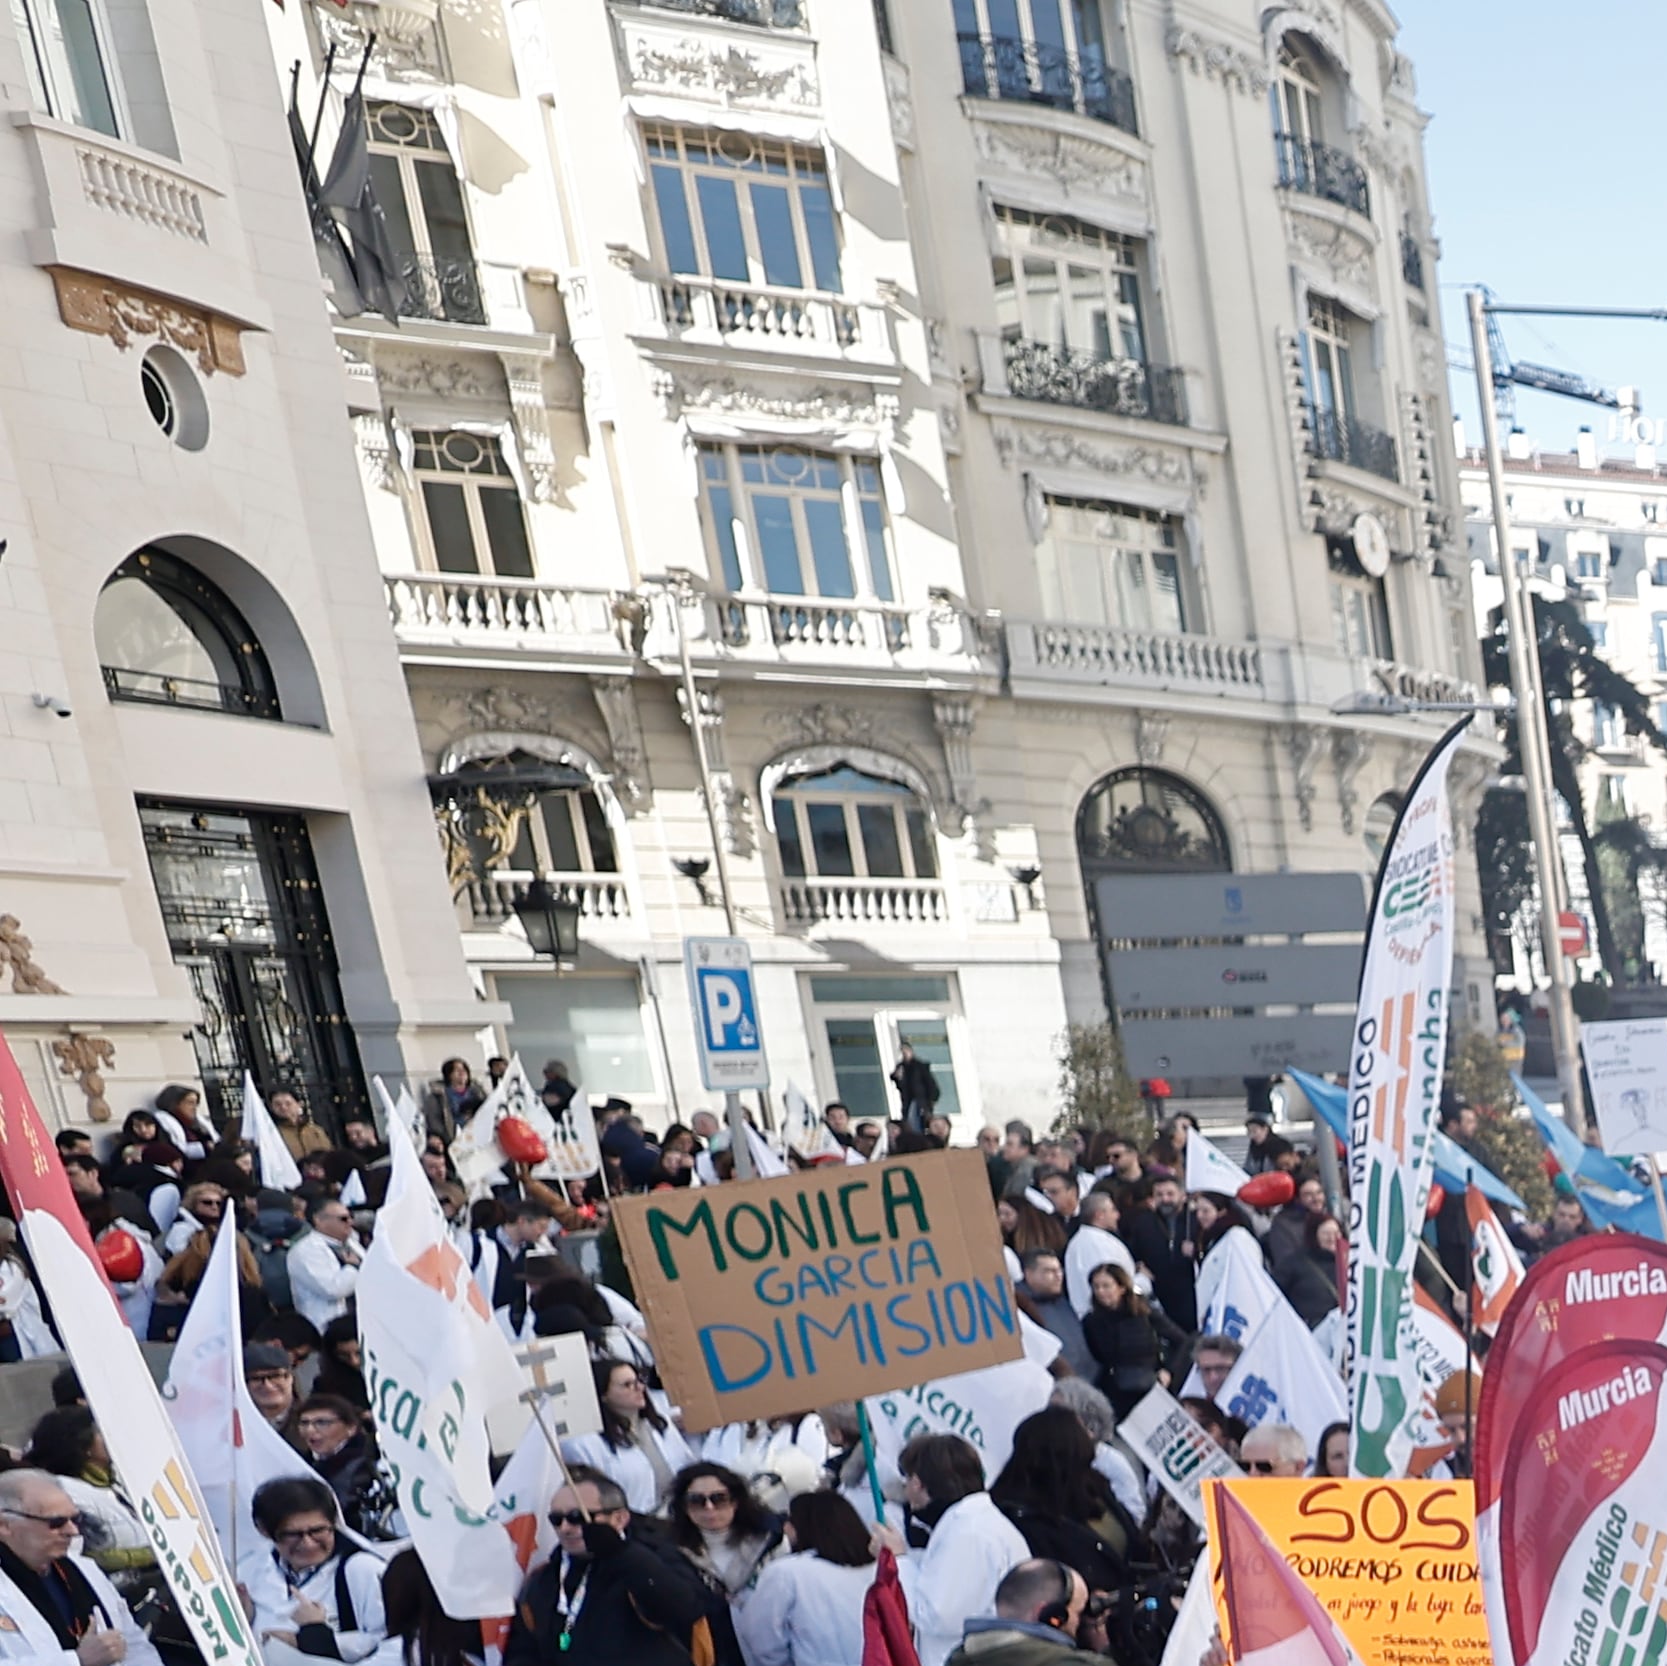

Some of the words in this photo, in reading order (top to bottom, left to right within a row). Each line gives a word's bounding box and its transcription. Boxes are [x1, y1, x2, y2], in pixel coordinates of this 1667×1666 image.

[704, 975, 742, 1046] P
[646, 1166, 931, 1281] MONICA
[754, 1238, 943, 1307] GARCIA
[698, 1274, 1014, 1393] DIMISION
[1558, 1366, 1653, 1432] Murcia
[1289, 1482, 1470, 1551] SOS
[1284, 1554, 1402, 1585] PODREMOS
[1582, 1502, 1629, 1607] Médico
[1389, 1599, 1399, 1624] y
